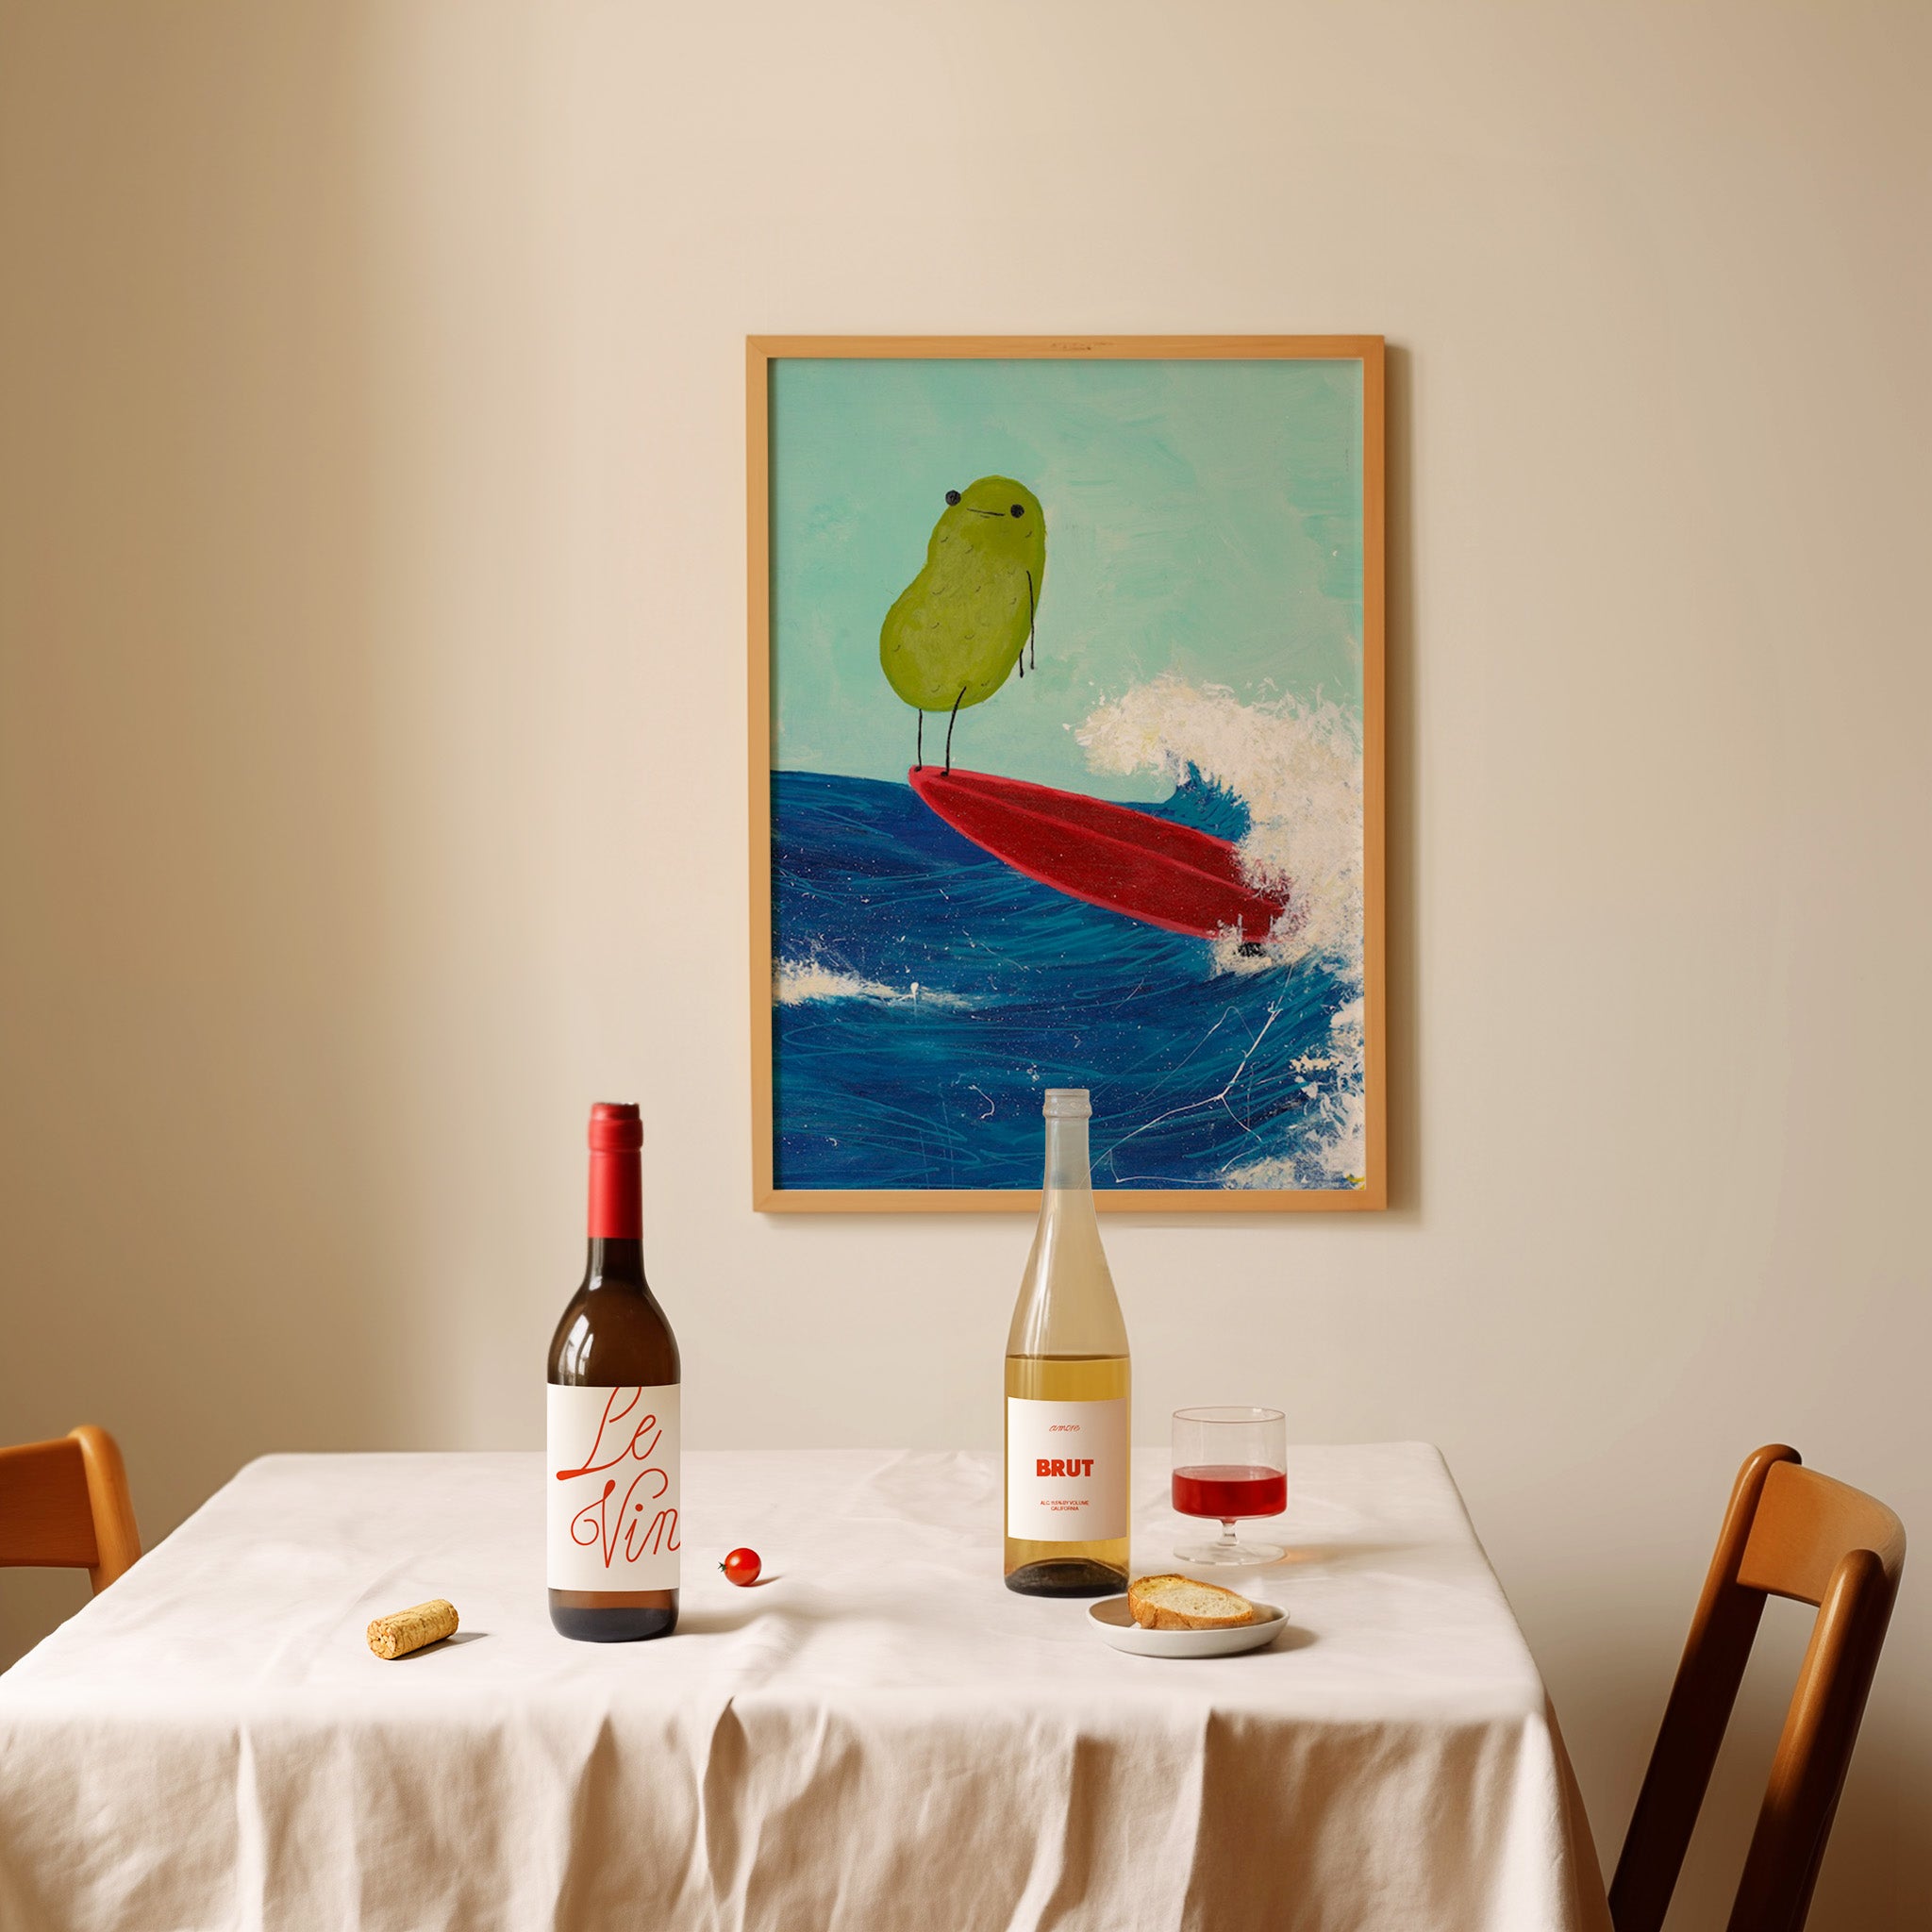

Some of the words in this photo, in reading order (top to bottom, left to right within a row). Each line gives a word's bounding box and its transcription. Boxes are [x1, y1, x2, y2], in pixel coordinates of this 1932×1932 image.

[556, 1386, 662, 1481] Le
[1036, 1458, 1094, 1477] BRUT
[571, 1468, 680, 1569] Vin
